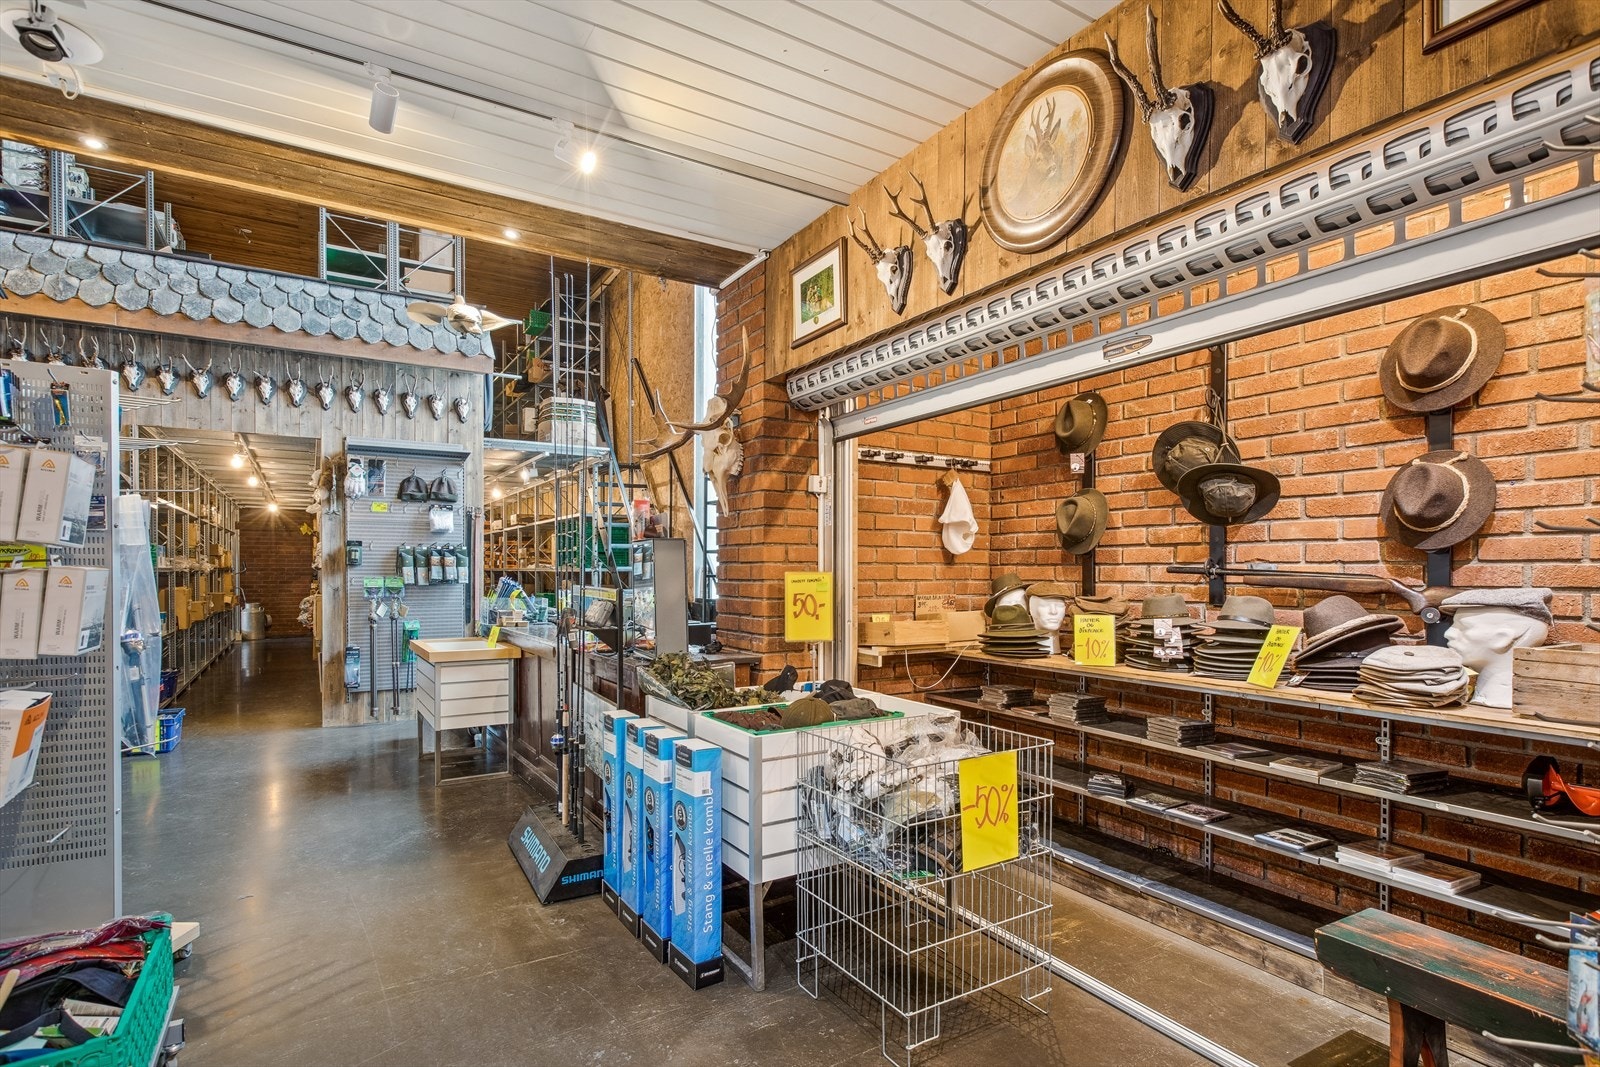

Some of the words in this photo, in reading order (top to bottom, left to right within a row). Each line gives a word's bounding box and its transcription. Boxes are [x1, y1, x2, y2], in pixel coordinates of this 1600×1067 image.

[1076, 637, 1110, 660] -10%
[962, 784, 1014, 828] -50%
[520, 826, 551, 874] SHIMANO
[703, 838, 714, 876] snelle
[562, 870, 604, 885] SHIMAN
[703, 881, 713, 890] &
[703, 894, 715, 933] Stang
